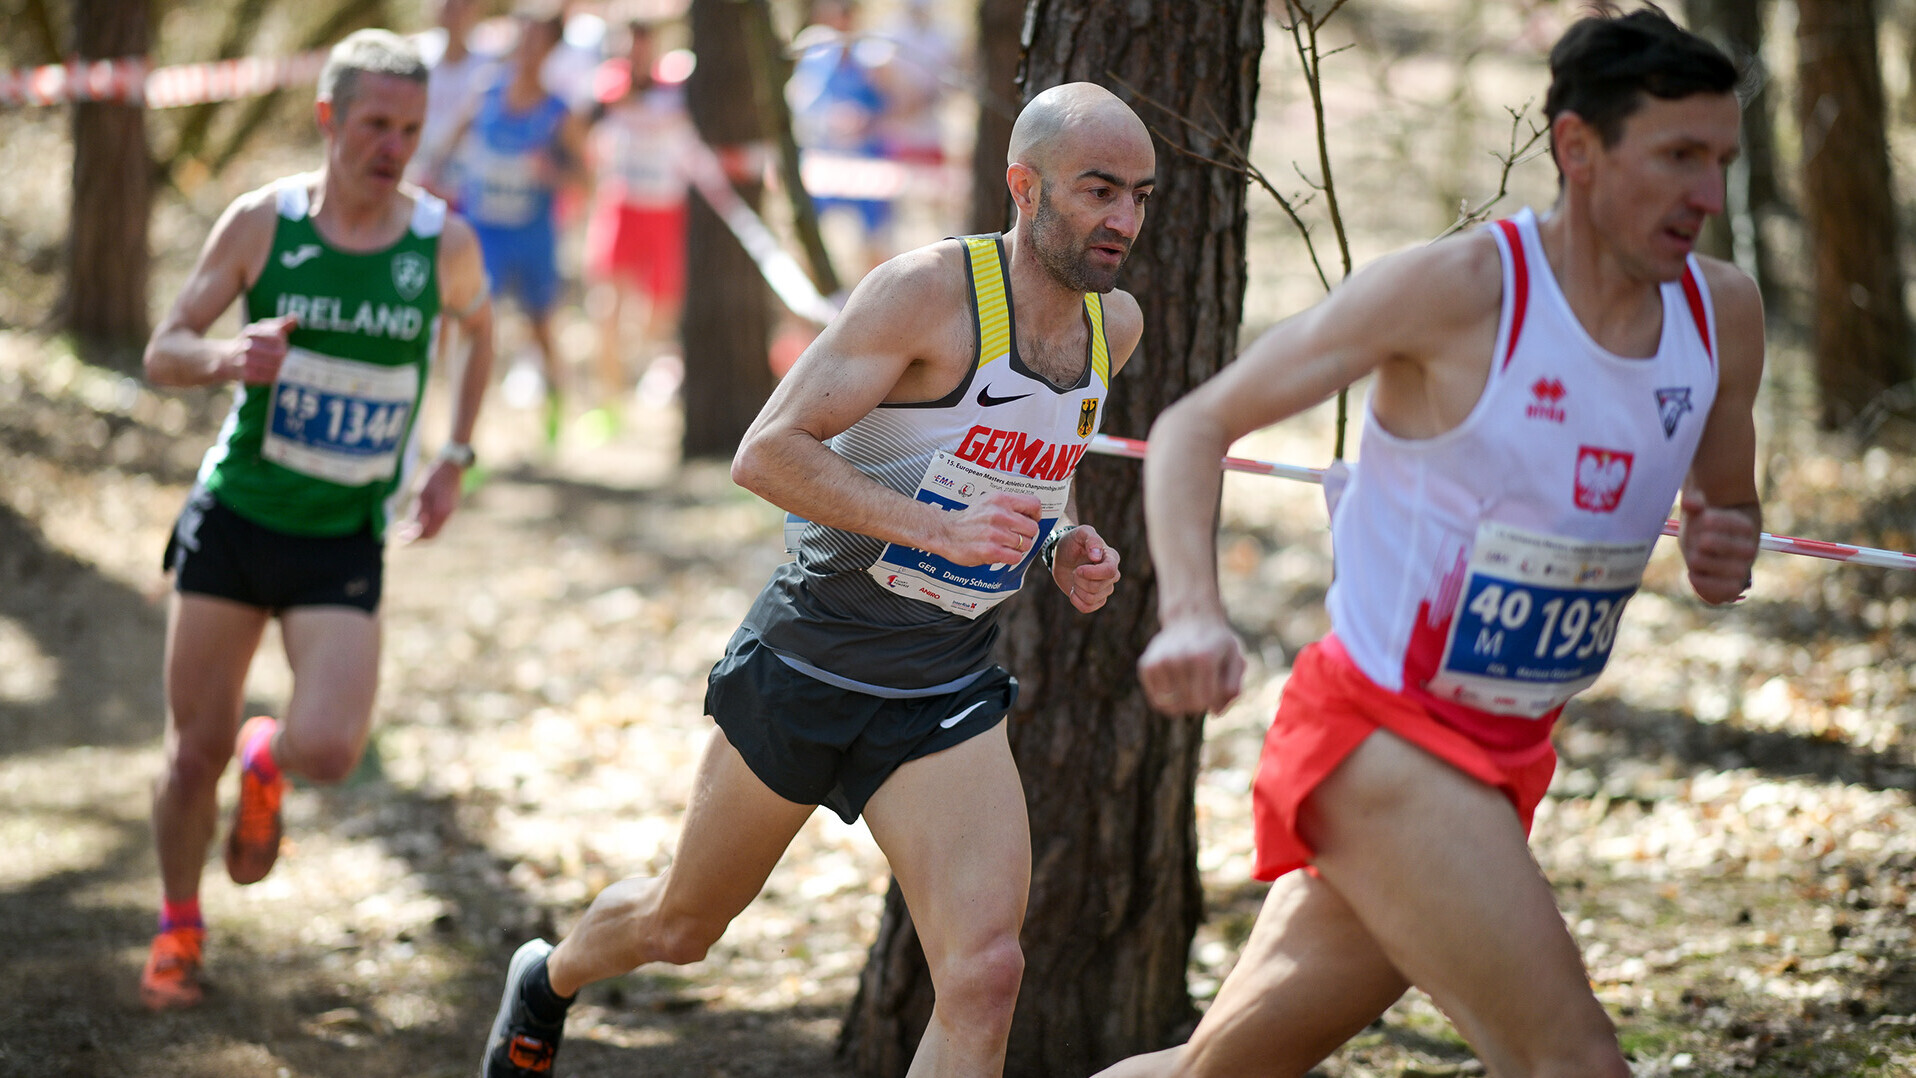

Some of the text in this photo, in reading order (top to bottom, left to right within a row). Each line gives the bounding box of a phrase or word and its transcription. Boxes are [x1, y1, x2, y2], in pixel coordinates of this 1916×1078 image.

[276, 293, 423, 341] IRELAND
[954, 425, 1088, 481] GERMANY
[935, 474, 954, 488] EMA
[946, 459, 955, 467] 15.
[955, 463, 983, 478] European
[983, 473, 1005, 485] Masters
[1005, 480, 1025, 488] Athletics
[918, 561, 937, 574] GER
[942, 571, 970, 584] Danny
[919, 587, 941, 600] ANIRO
[1469, 583, 1532, 630] 40
[1473, 627, 1504, 658] M
